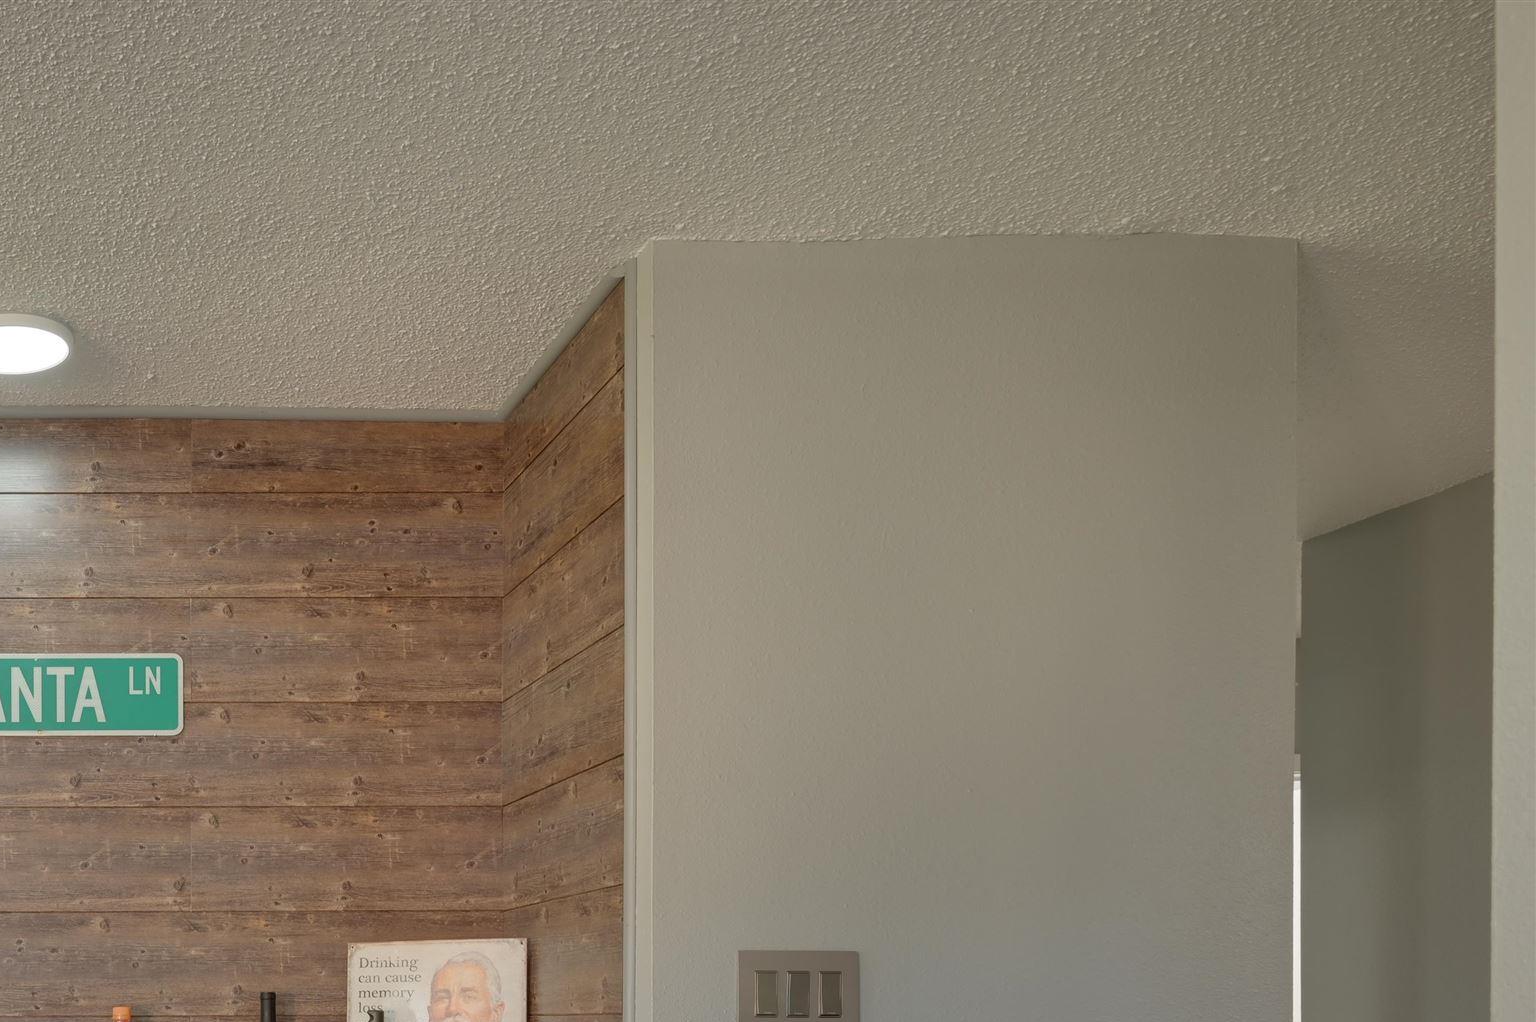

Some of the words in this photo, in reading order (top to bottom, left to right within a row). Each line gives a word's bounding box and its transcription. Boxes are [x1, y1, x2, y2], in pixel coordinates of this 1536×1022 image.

[128, 665, 162, 695] LN
[358, 957, 419, 973] Drinking
[358, 975, 381, 984] can
[385, 974, 422, 983] cause
[358, 988, 416, 1002] memory
